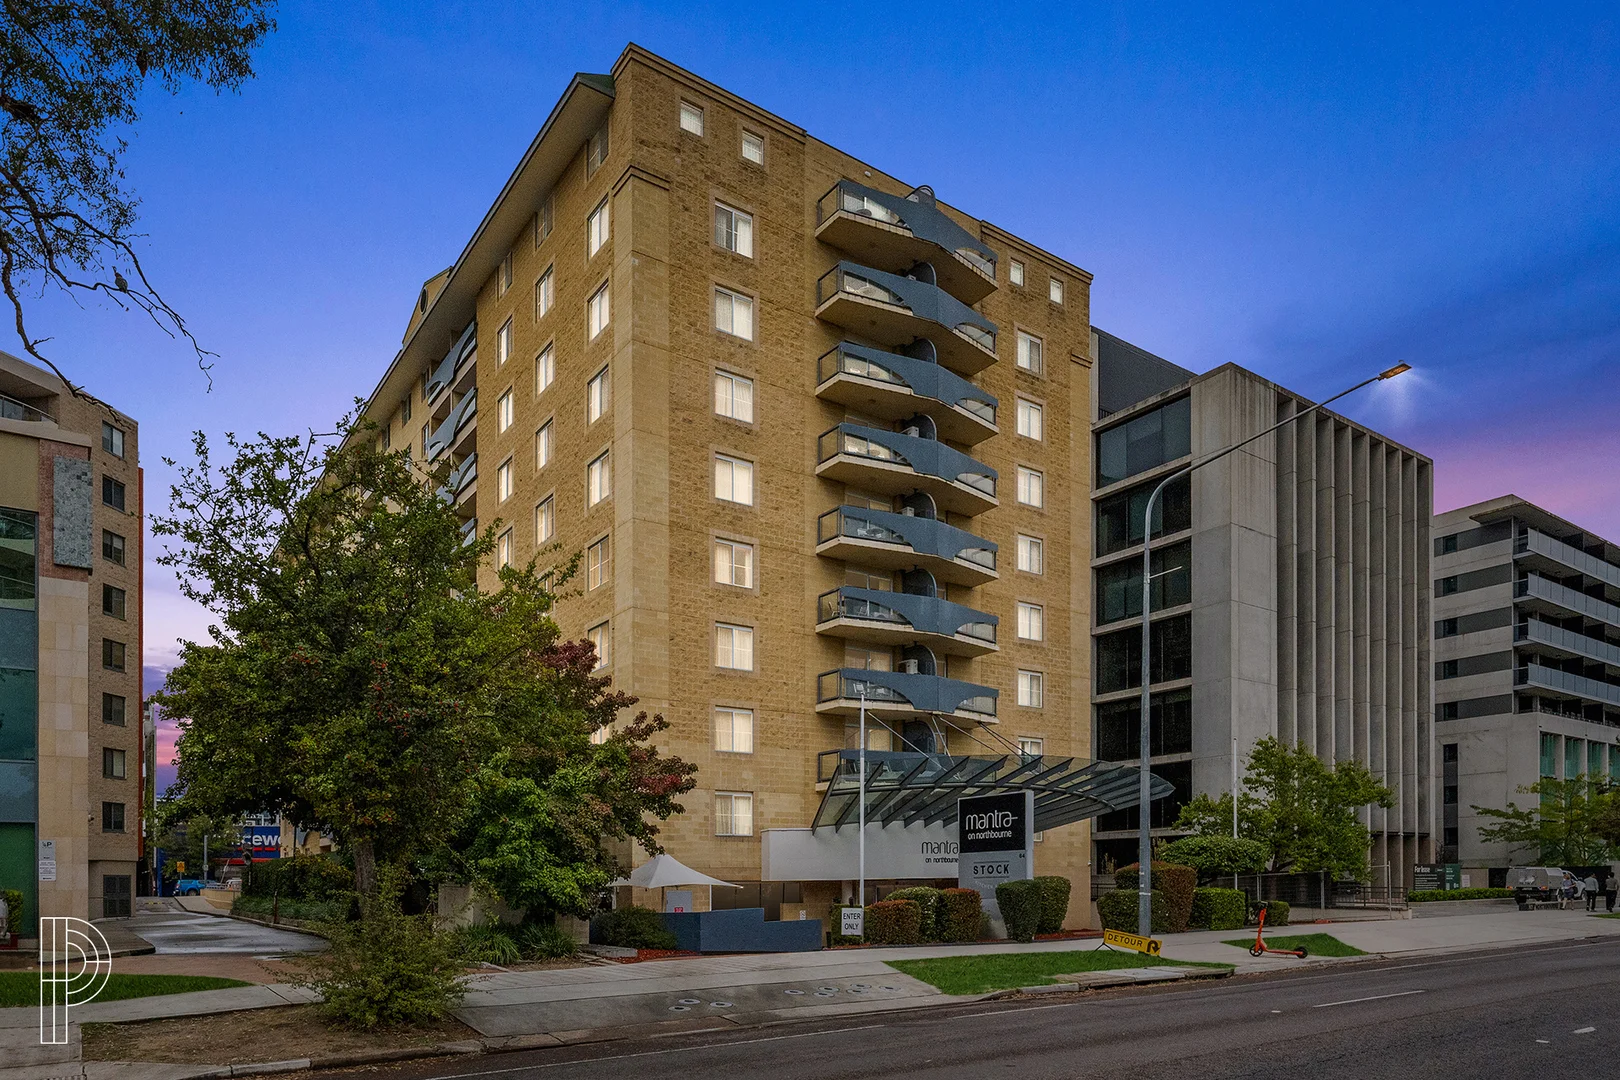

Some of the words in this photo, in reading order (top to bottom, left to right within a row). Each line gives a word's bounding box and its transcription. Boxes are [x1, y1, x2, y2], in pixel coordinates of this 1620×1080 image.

[965, 810, 1018, 830] mantra
[976, 830, 1012, 840] northbourne
[973, 864, 1010, 875] STOCK
[1421, 865, 1431, 873] lease
[843, 912, 861, 920] ENTER
[844, 922, 859, 930] ONLY
[1108, 933, 1143, 947] DETOUR
